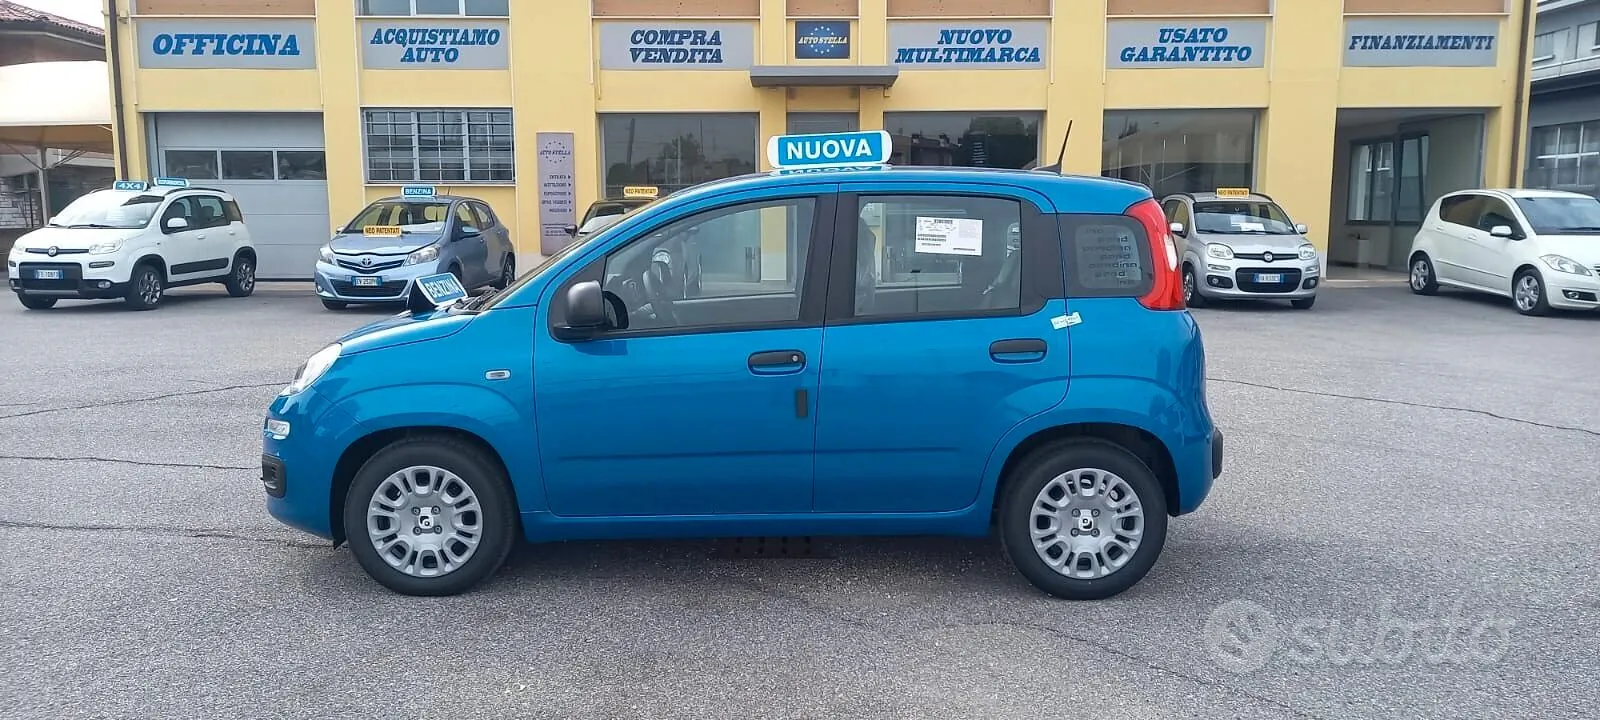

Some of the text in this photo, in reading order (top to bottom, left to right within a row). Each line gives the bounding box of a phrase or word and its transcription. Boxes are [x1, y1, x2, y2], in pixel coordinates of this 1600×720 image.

[370, 28, 501, 47] ACQUISTIAMO
[630, 29, 722, 46] COMPRA
[798, 36, 848, 44] AUTO STELLA
[937, 29, 1013, 45] NUOVO
[1158, 27, 1229, 44] USATO
[1348, 34, 1496, 51] FINANZIAMENTI
[152, 33, 301, 56] OFFICINA
[400, 47, 460, 63] AUTO
[629, 47, 724, 64] VENDITA
[894, 47, 1041, 64] MULTIMARCA
[1119, 45, 1253, 63] GARANTITO
[787, 138, 872, 160] NUOVA
[365, 227, 400, 235] NEO PATENTATI
[425, 278, 464, 297] BENZINA
